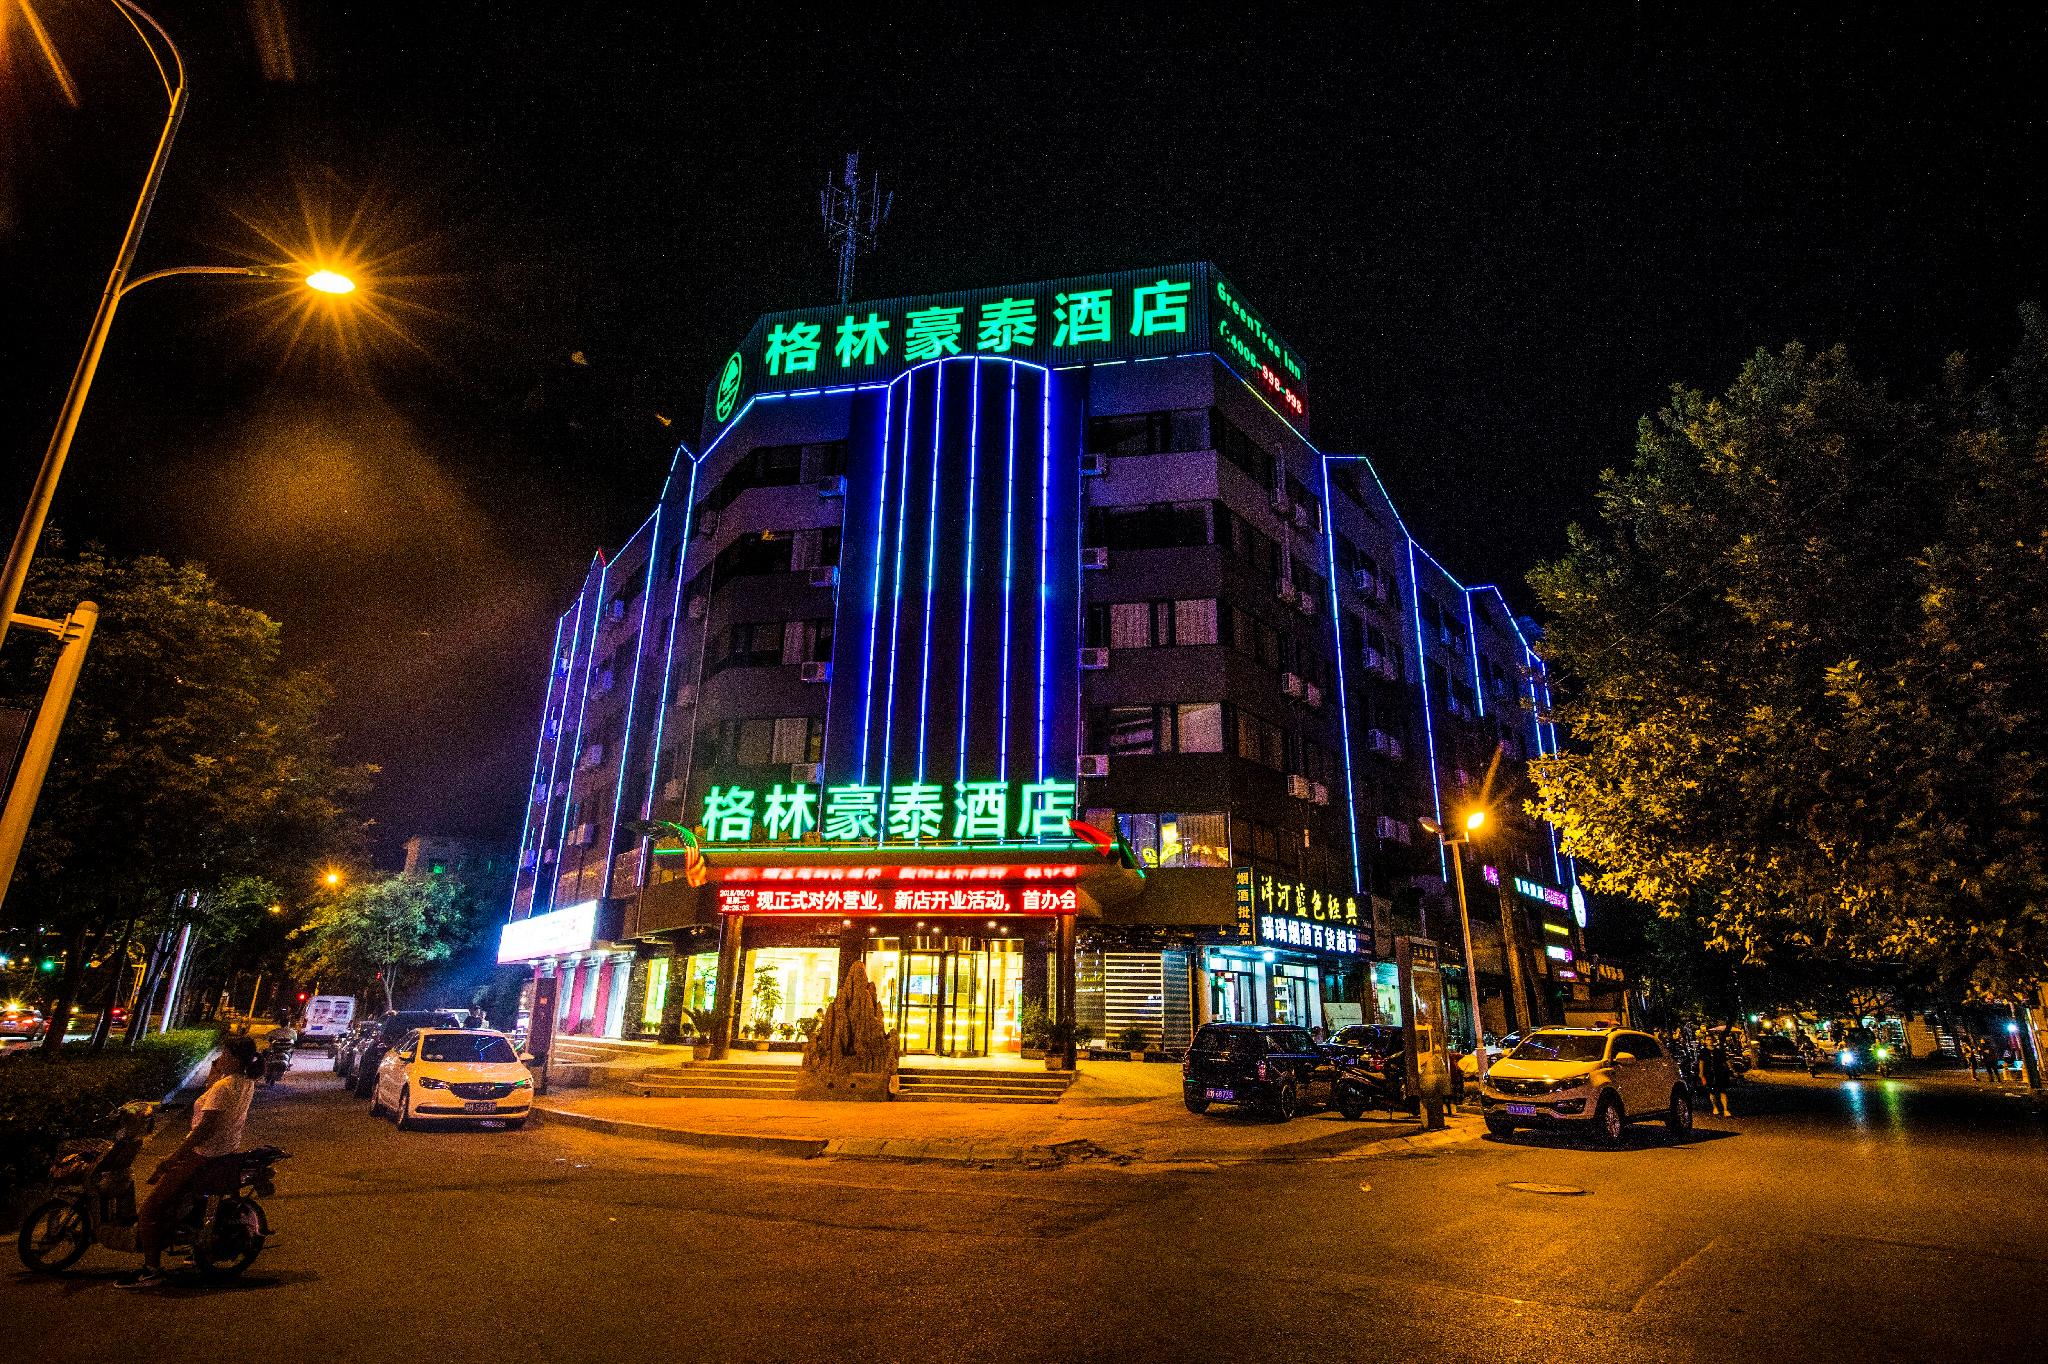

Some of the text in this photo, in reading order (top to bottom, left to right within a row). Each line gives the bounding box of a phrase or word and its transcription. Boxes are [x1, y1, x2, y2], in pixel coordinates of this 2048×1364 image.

[765, 279, 1192, 376] 格林豪泰酒店
[1216, 281, 1301, 380] GreenTree Inn
[702, 778, 1075, 841] 格林豪泰酒店
[1022, 890, 1076, 910] 首办会
[1236, 872, 1251, 936] 烟酒批发
